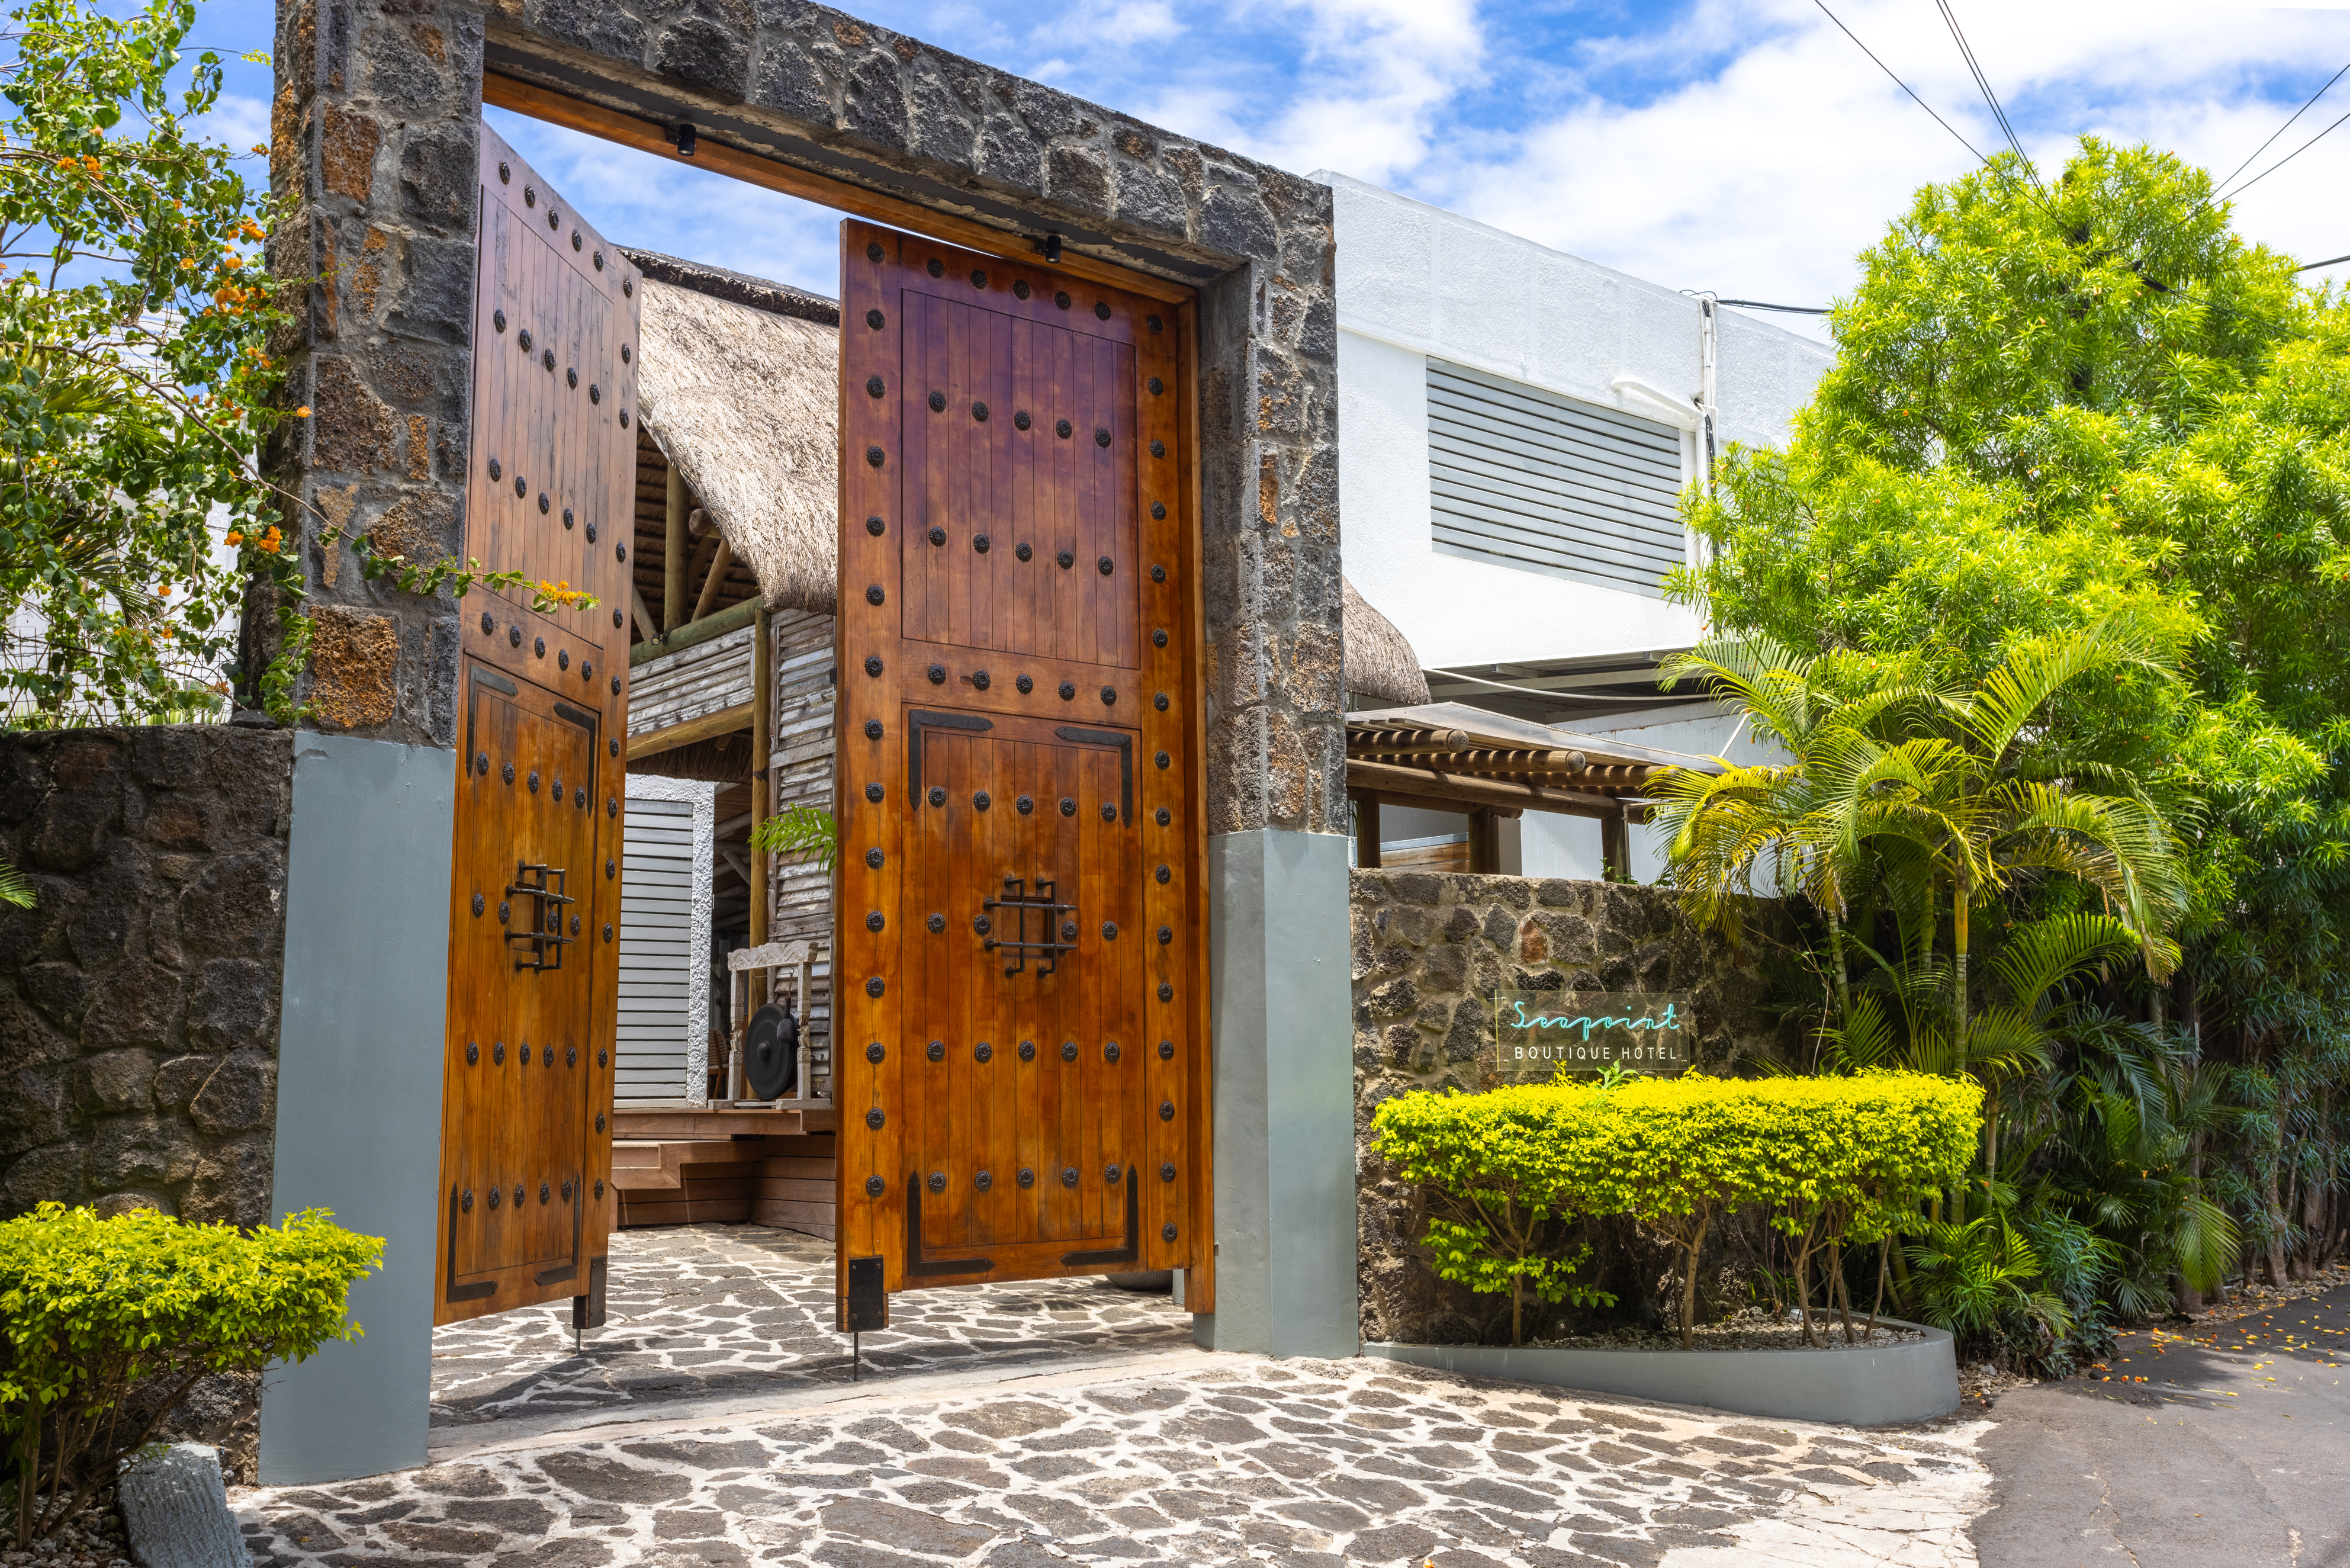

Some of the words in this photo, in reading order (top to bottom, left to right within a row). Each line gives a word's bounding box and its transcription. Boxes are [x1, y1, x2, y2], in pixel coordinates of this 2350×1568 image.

[1511, 1001, 1680, 1041] Seapoint
[1515, 1047, 1610, 1059] BOUTIQUE
[1622, 1047, 1676, 1059] HOTEL
